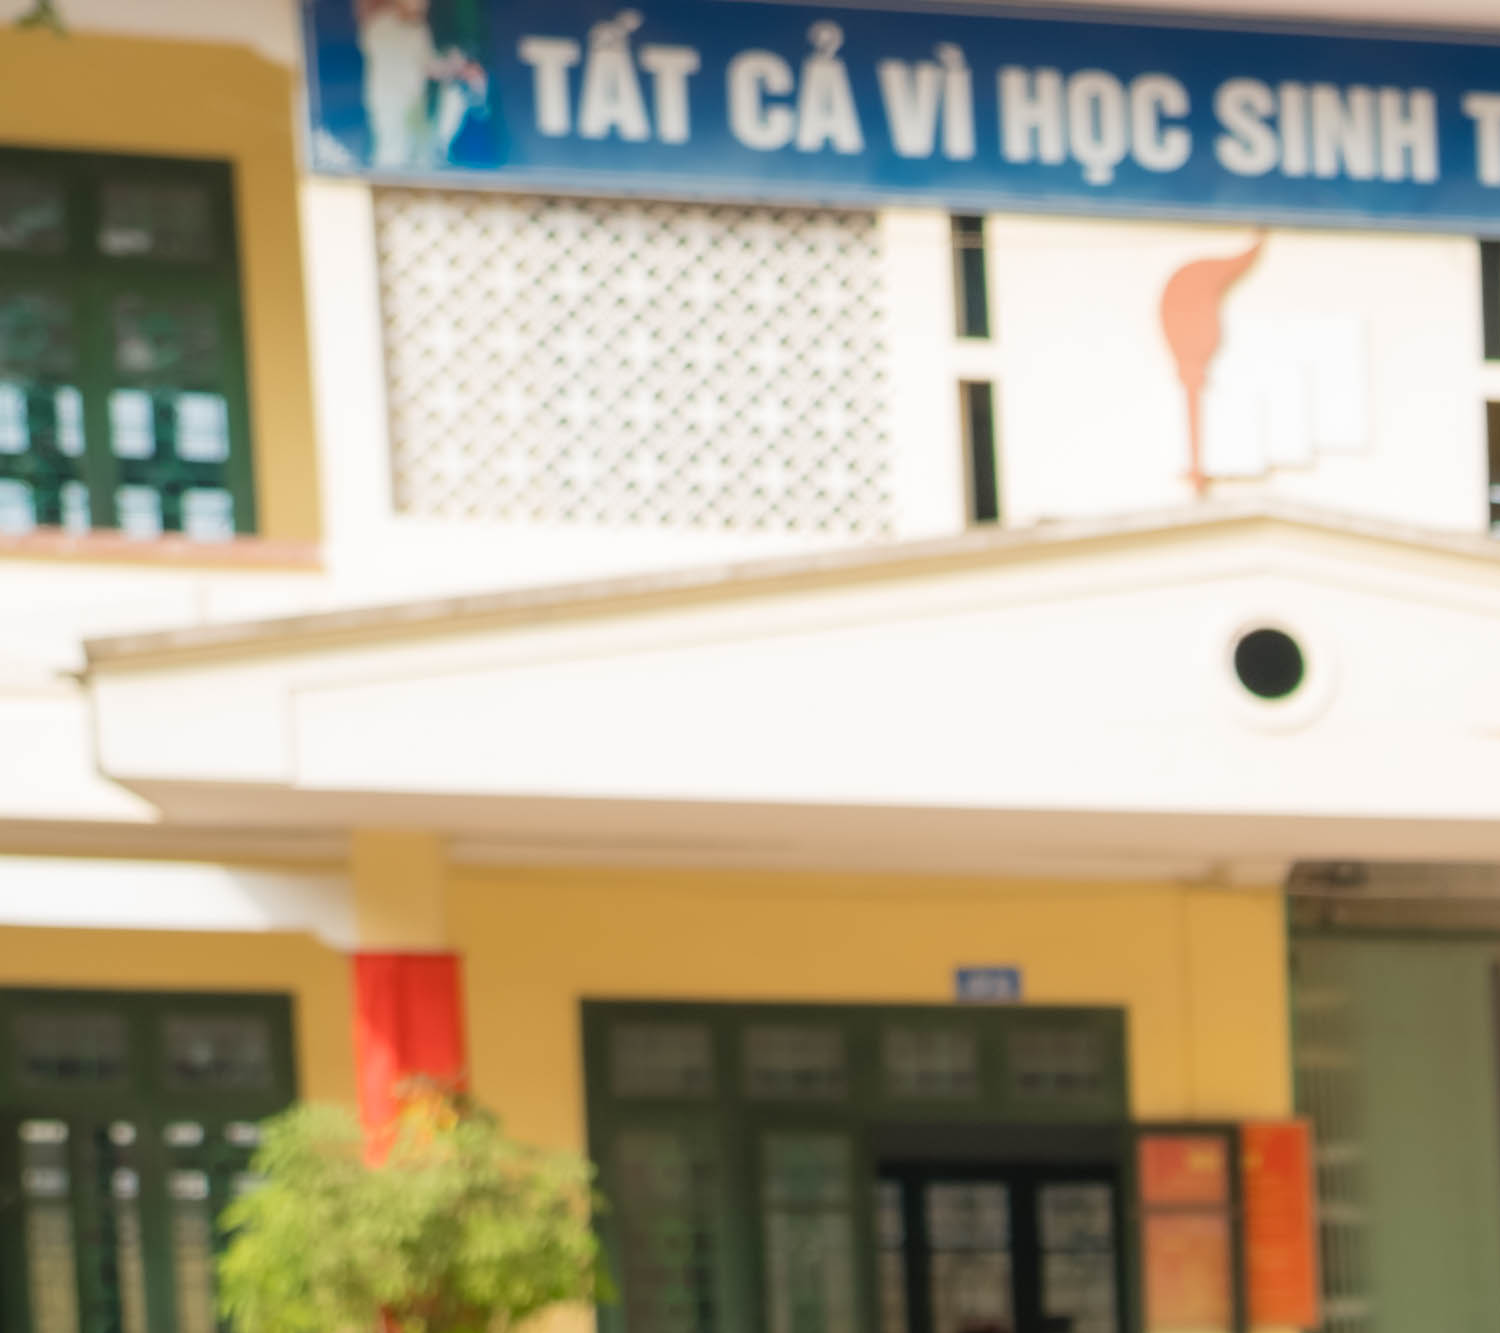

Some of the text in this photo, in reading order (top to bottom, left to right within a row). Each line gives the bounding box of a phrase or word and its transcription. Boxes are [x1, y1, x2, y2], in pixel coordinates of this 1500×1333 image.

[518, 10, 701, 145] TẤT
[725, 20, 866, 155] CẢ
[877, 41, 977, 161] VÌ
[1000, 66, 1192, 186] HỌC
[1214, 76, 1440, 184] SINH
